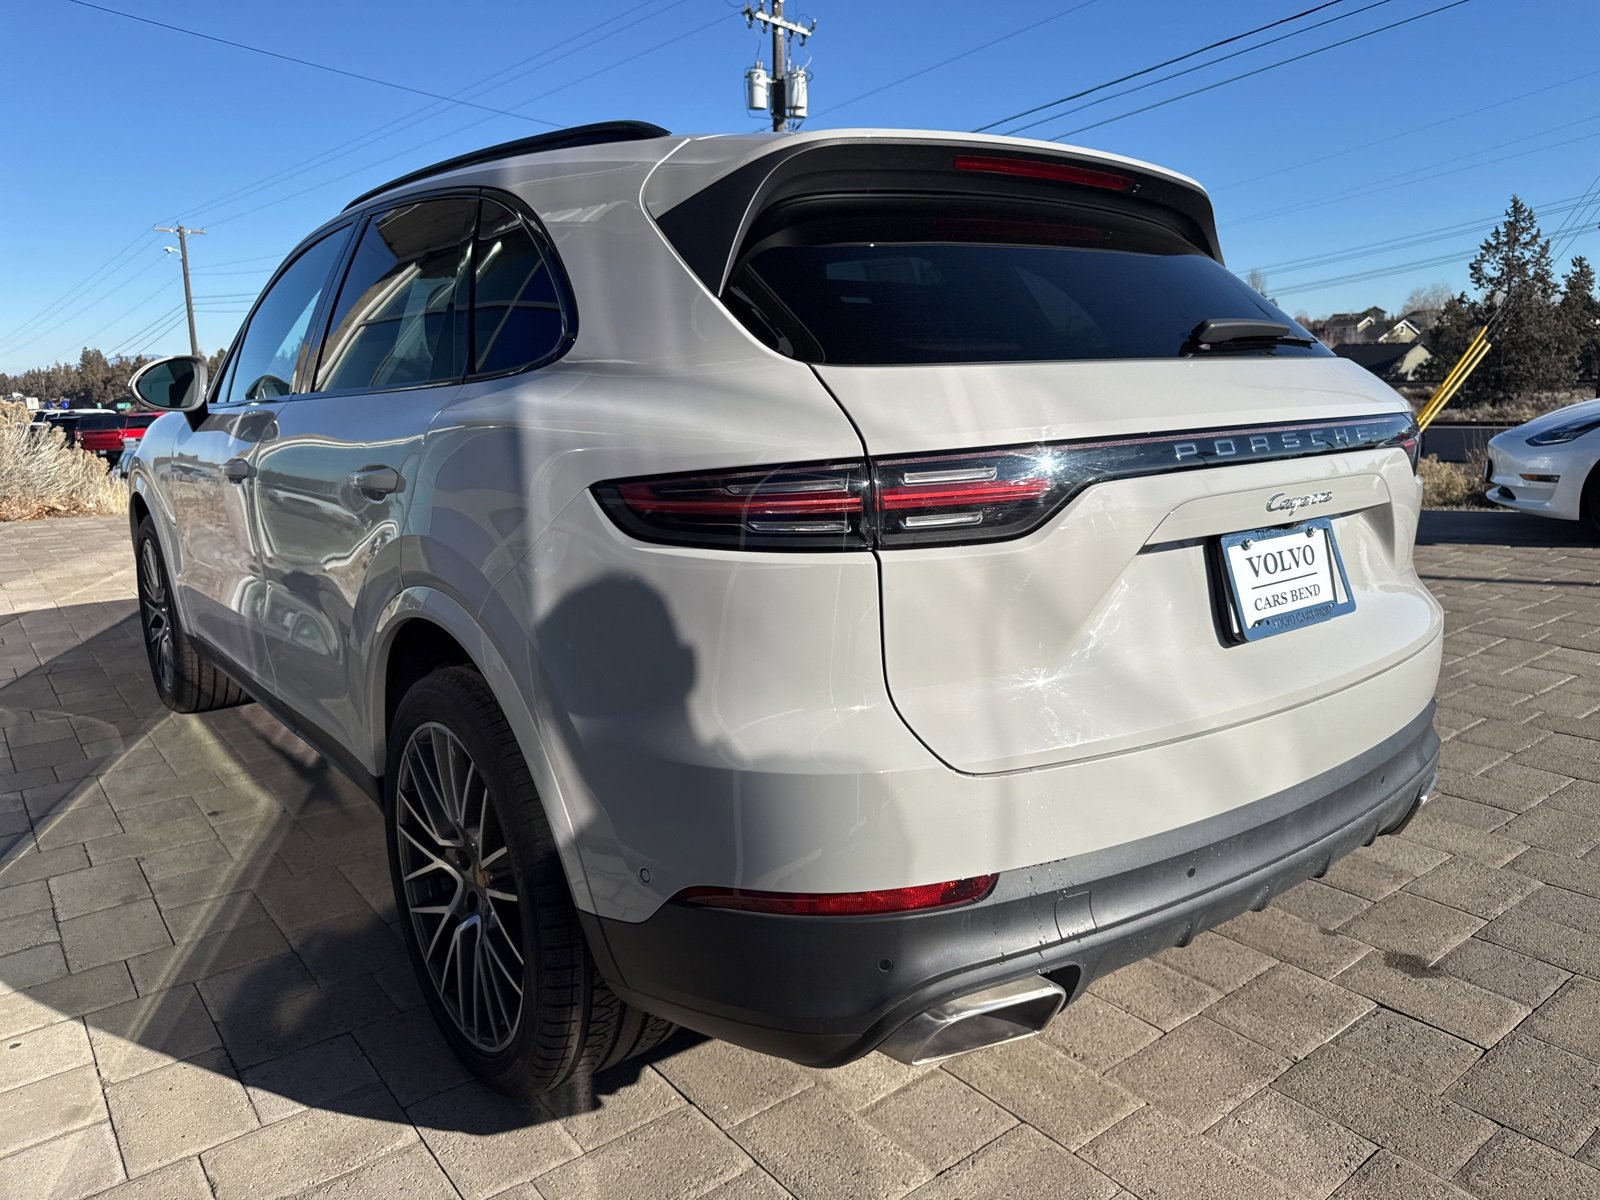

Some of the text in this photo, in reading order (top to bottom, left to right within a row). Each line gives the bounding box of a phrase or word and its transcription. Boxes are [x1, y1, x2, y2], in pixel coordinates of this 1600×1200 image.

[1174, 427, 1371, 461] PORSCHE
[1265, 490, 1333, 517] Cayenne
[1246, 544, 1315, 578] VOLVO
[1254, 583, 1321, 611] CARS BEND
